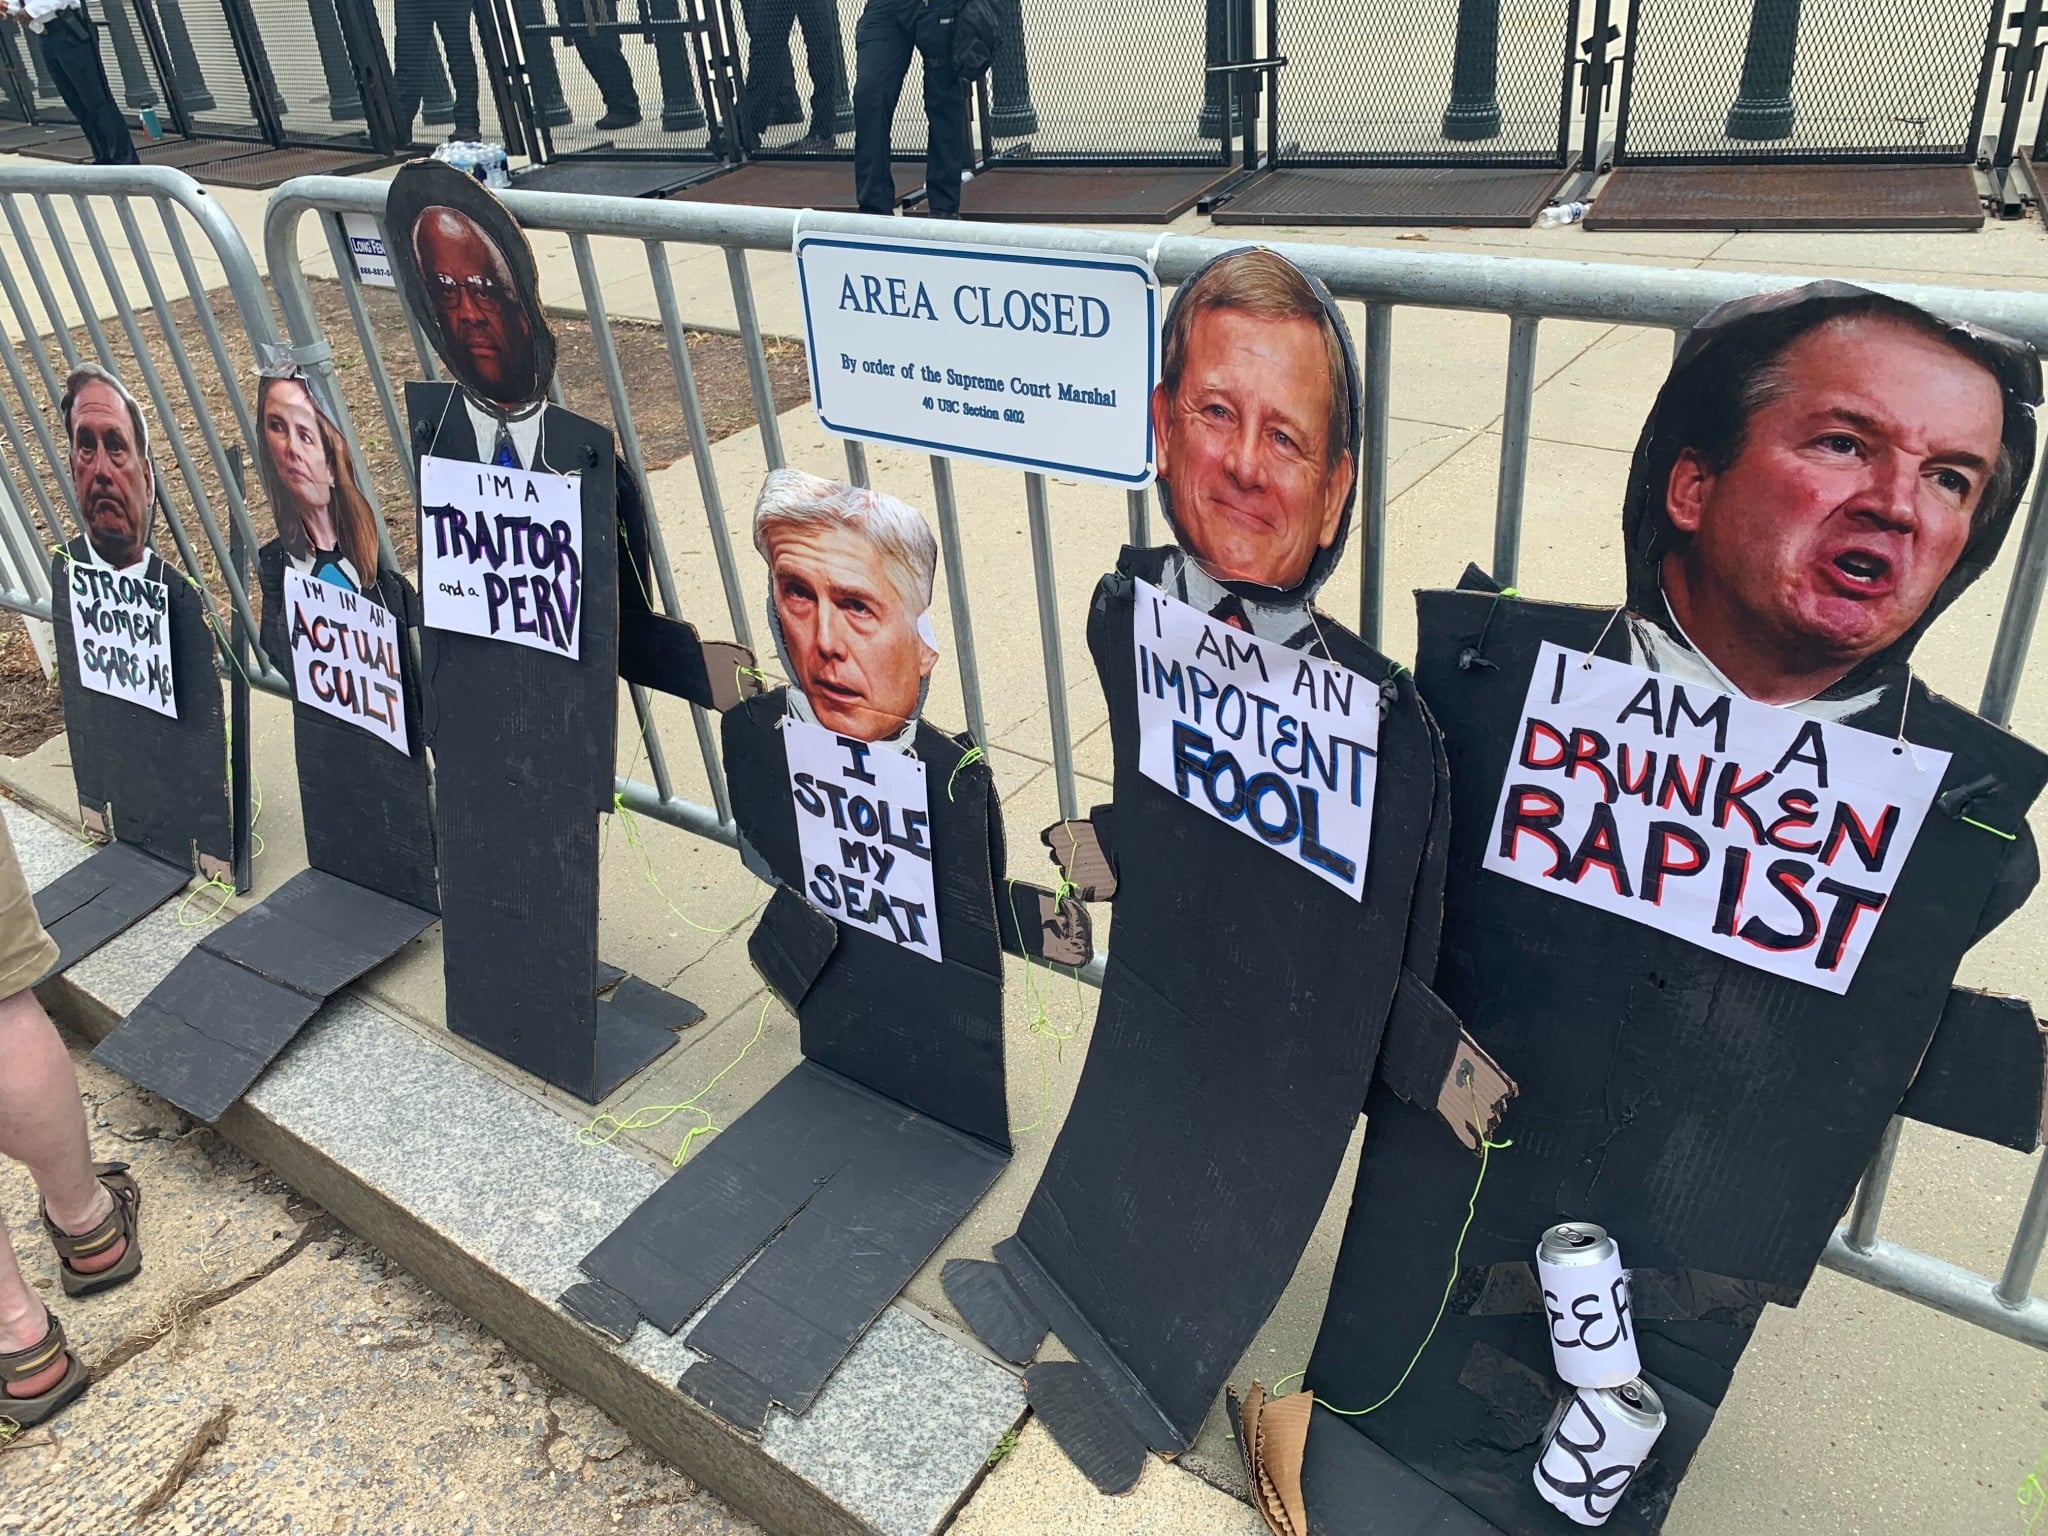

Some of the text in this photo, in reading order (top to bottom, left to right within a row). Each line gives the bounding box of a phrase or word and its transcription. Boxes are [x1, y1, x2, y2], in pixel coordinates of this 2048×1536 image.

[351, 239, 372, 253] LONG
[838, 273, 1110, 339] AREA CLOSED
[840, 353, 1117, 407] By order of the Supreme Court Marshal
[922, 396, 934, 410] 40
[937, 398, 960, 414] USC
[963, 402, 1000, 420] Section
[477, 473, 539, 503] I'M A
[422, 502, 581, 579] TRAITOR
[72, 566, 166, 615] STRONG
[77, 599, 162, 648] WOMEN
[302, 579, 385, 628] I'M IN AN
[439, 572, 580, 653] and a PERV
[83, 639, 172, 707] SCARE ME
[291, 601, 400, 680] ACTUAL
[1152, 597, 1354, 716] I AM AN
[309, 660, 398, 733] CULT
[1139, 645, 1377, 807] IMPOTENT
[1551, 653, 1828, 788] I AM A
[836, 735, 876, 786] I
[1519, 717, 1901, 873] DRUNKEN
[793, 772, 931, 861] STOLE
[1172, 719, 1357, 885] FOOL
[839, 837, 895, 885] MY
[1499, 784, 1888, 972] RAPIST
[809, 864, 929, 946] SEAT
